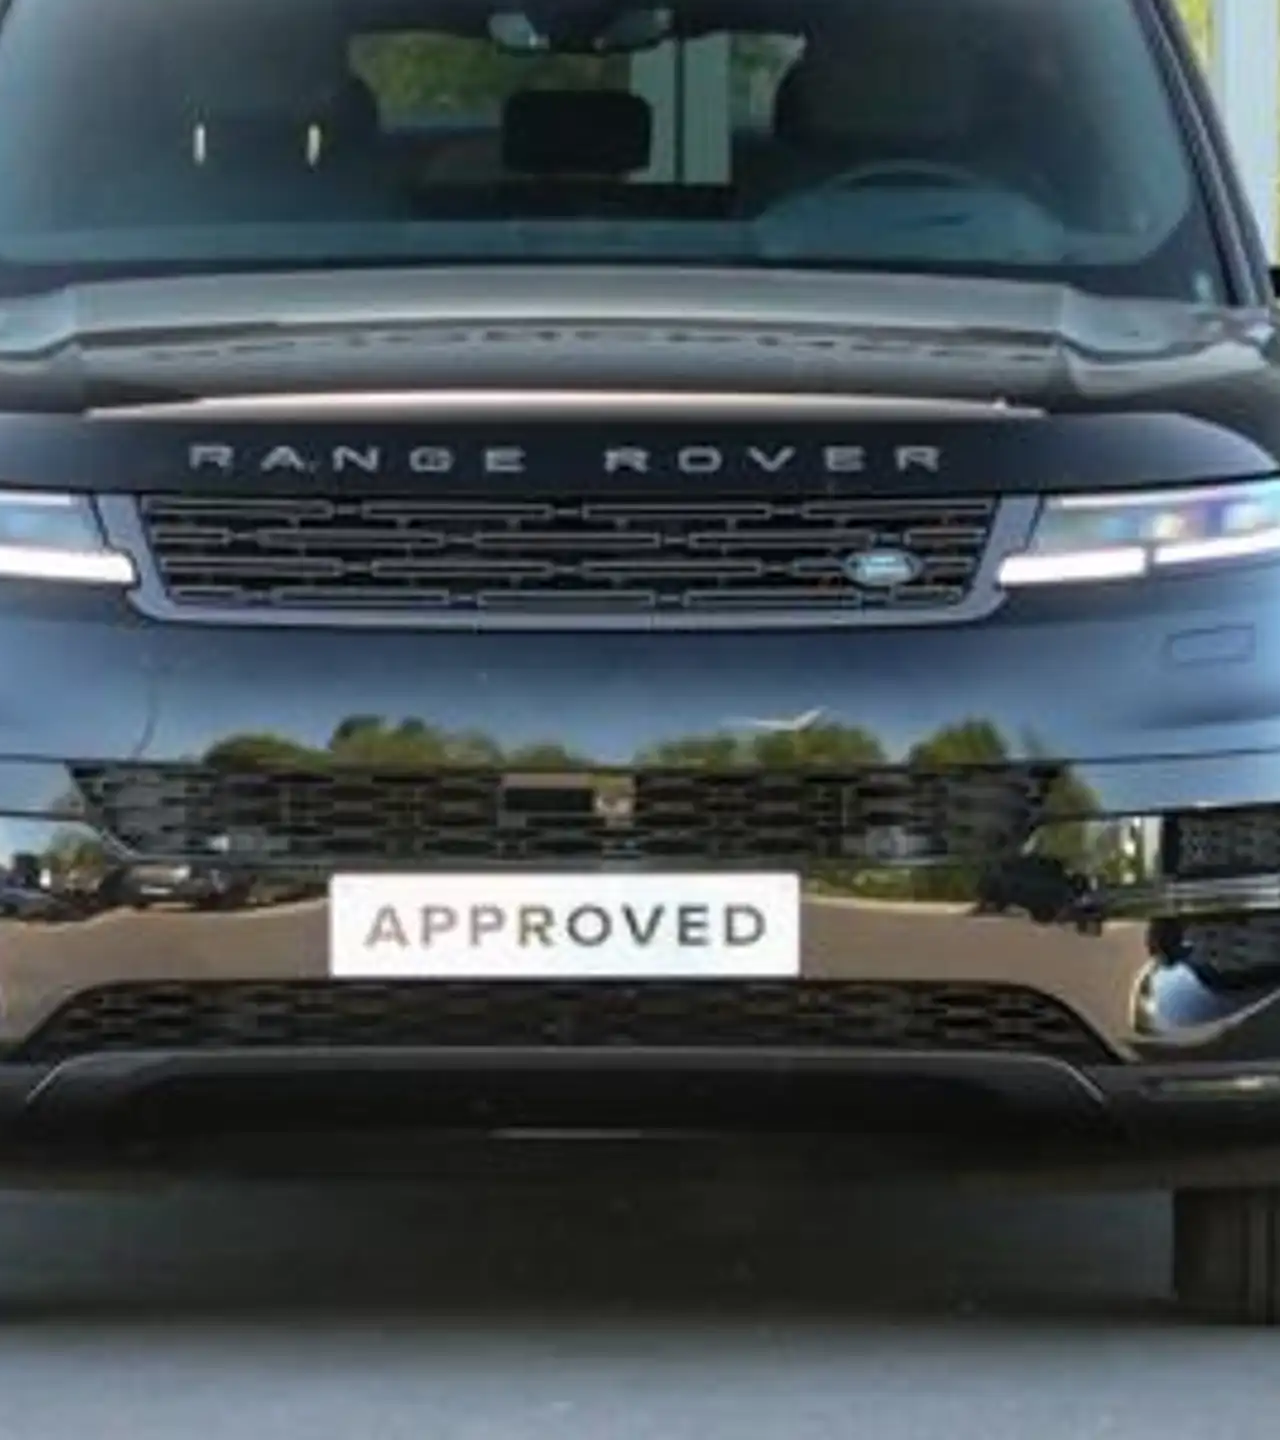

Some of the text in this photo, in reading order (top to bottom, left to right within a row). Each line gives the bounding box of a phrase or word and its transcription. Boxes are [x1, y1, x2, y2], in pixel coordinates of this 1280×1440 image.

[187, 444, 944, 474] RANGE ROVER
[364, 904, 767, 948] APPROVED
